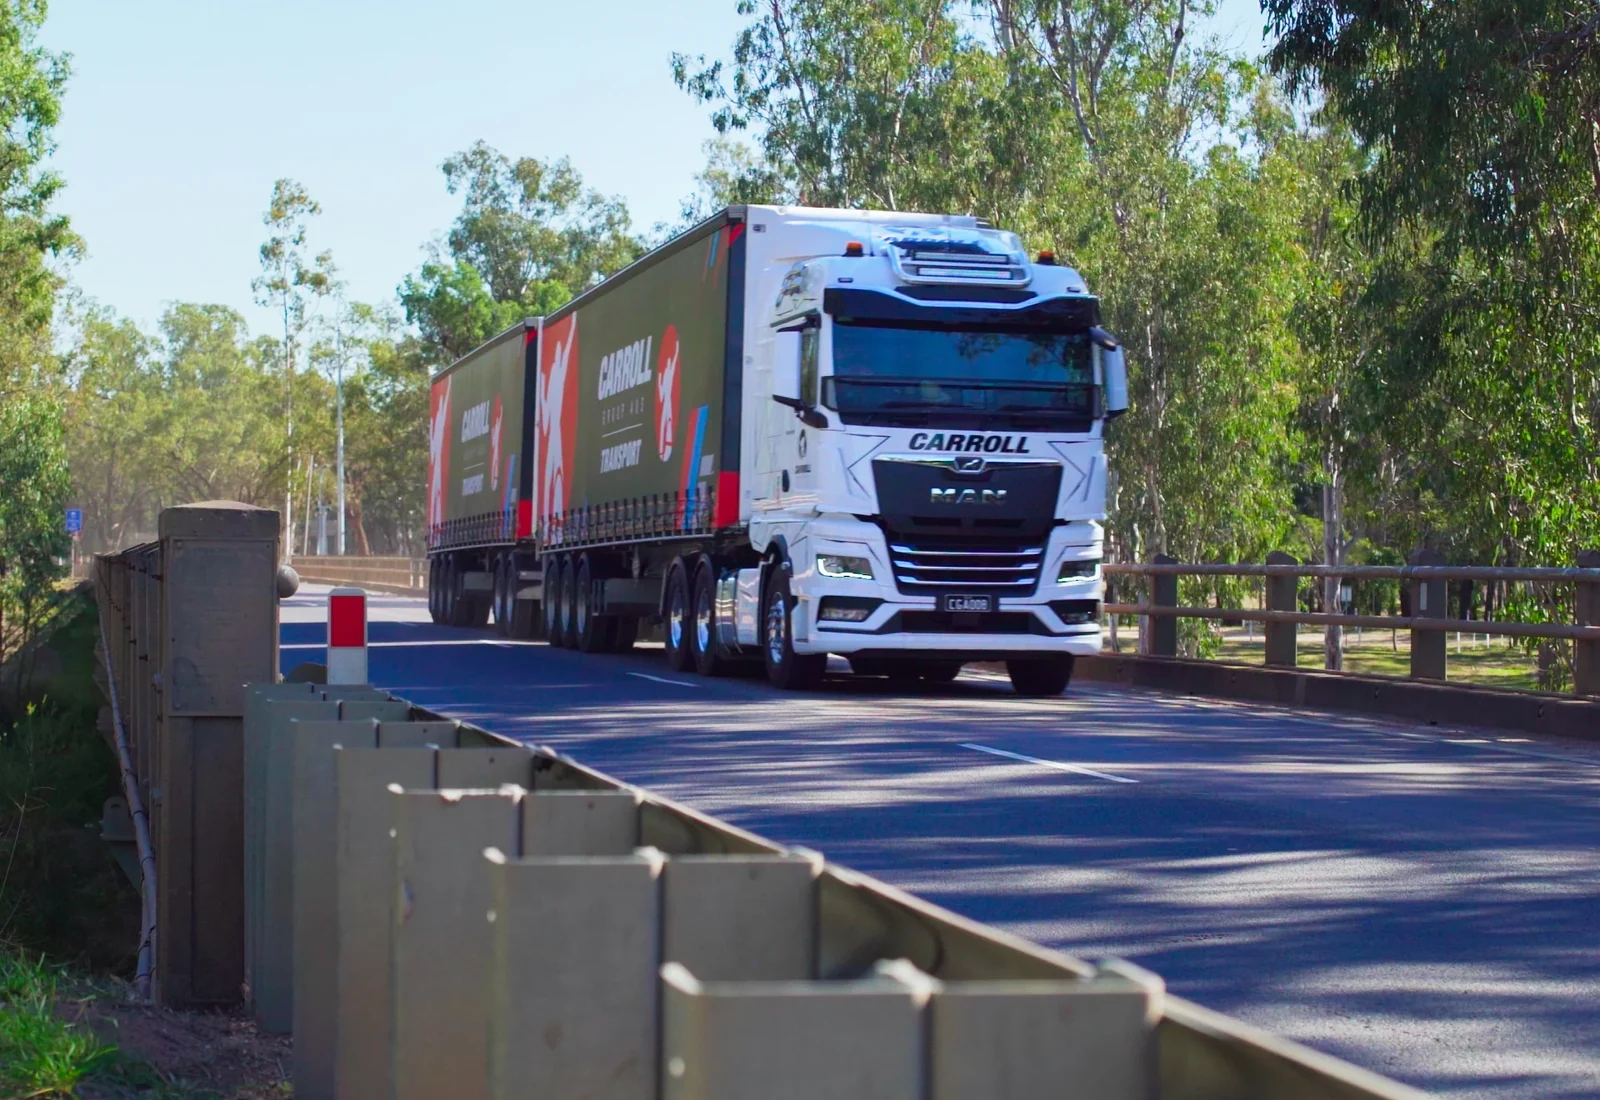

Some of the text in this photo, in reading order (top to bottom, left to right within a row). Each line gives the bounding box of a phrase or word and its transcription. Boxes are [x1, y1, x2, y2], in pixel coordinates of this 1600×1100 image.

[598, 336, 653, 401] CARROLL
[600, 439, 643, 474] TRANSPORT
[909, 432, 1030, 454] CARROLL
[930, 487, 1008, 505] MAN
